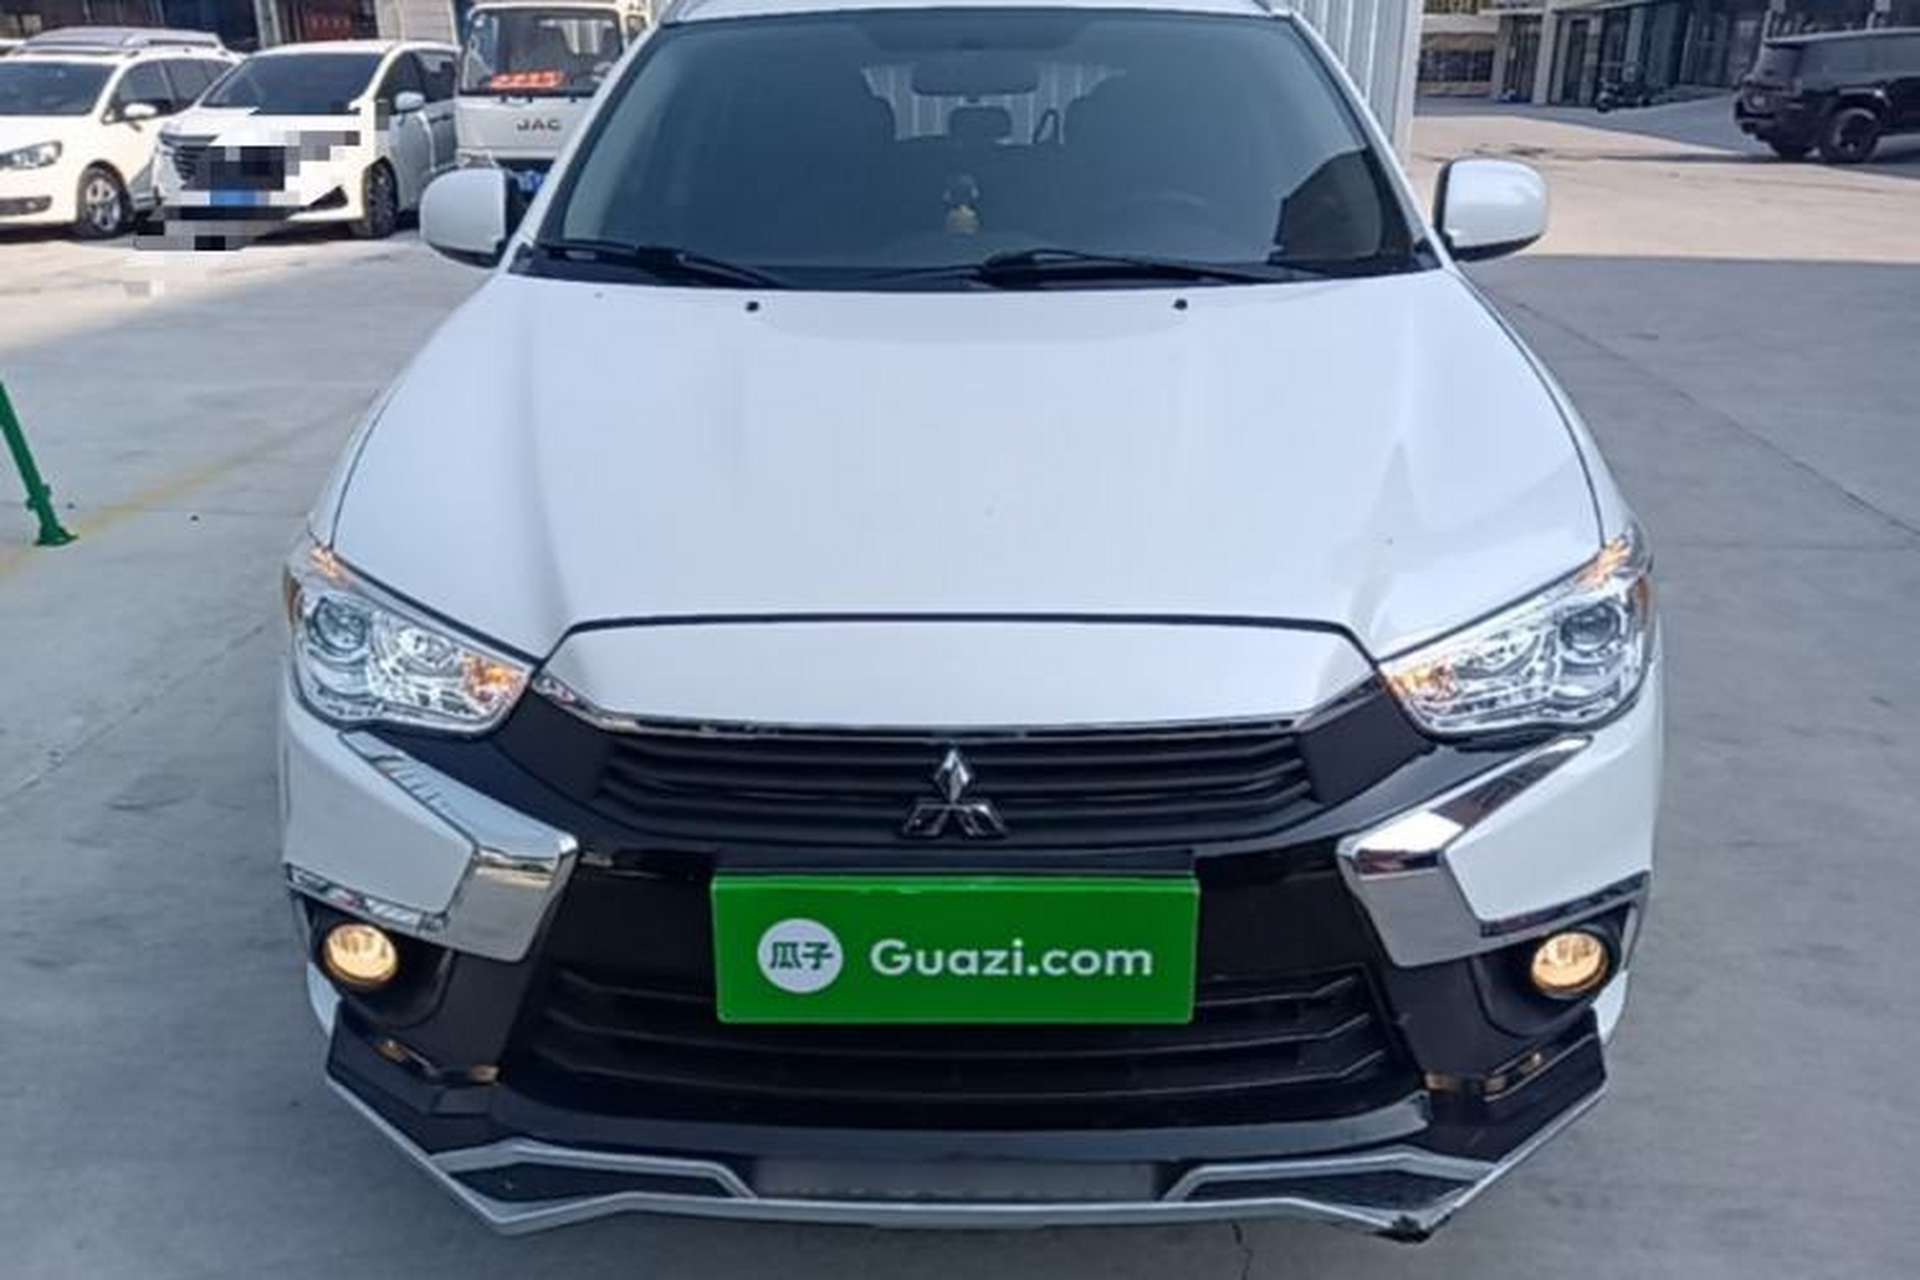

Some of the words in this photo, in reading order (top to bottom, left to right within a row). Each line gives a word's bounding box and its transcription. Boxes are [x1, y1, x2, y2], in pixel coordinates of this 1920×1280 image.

[516, 119, 561, 131] JAC
[769, 941, 833, 970] 瓜子
[870, 938, 1153, 976] Guazi.com
